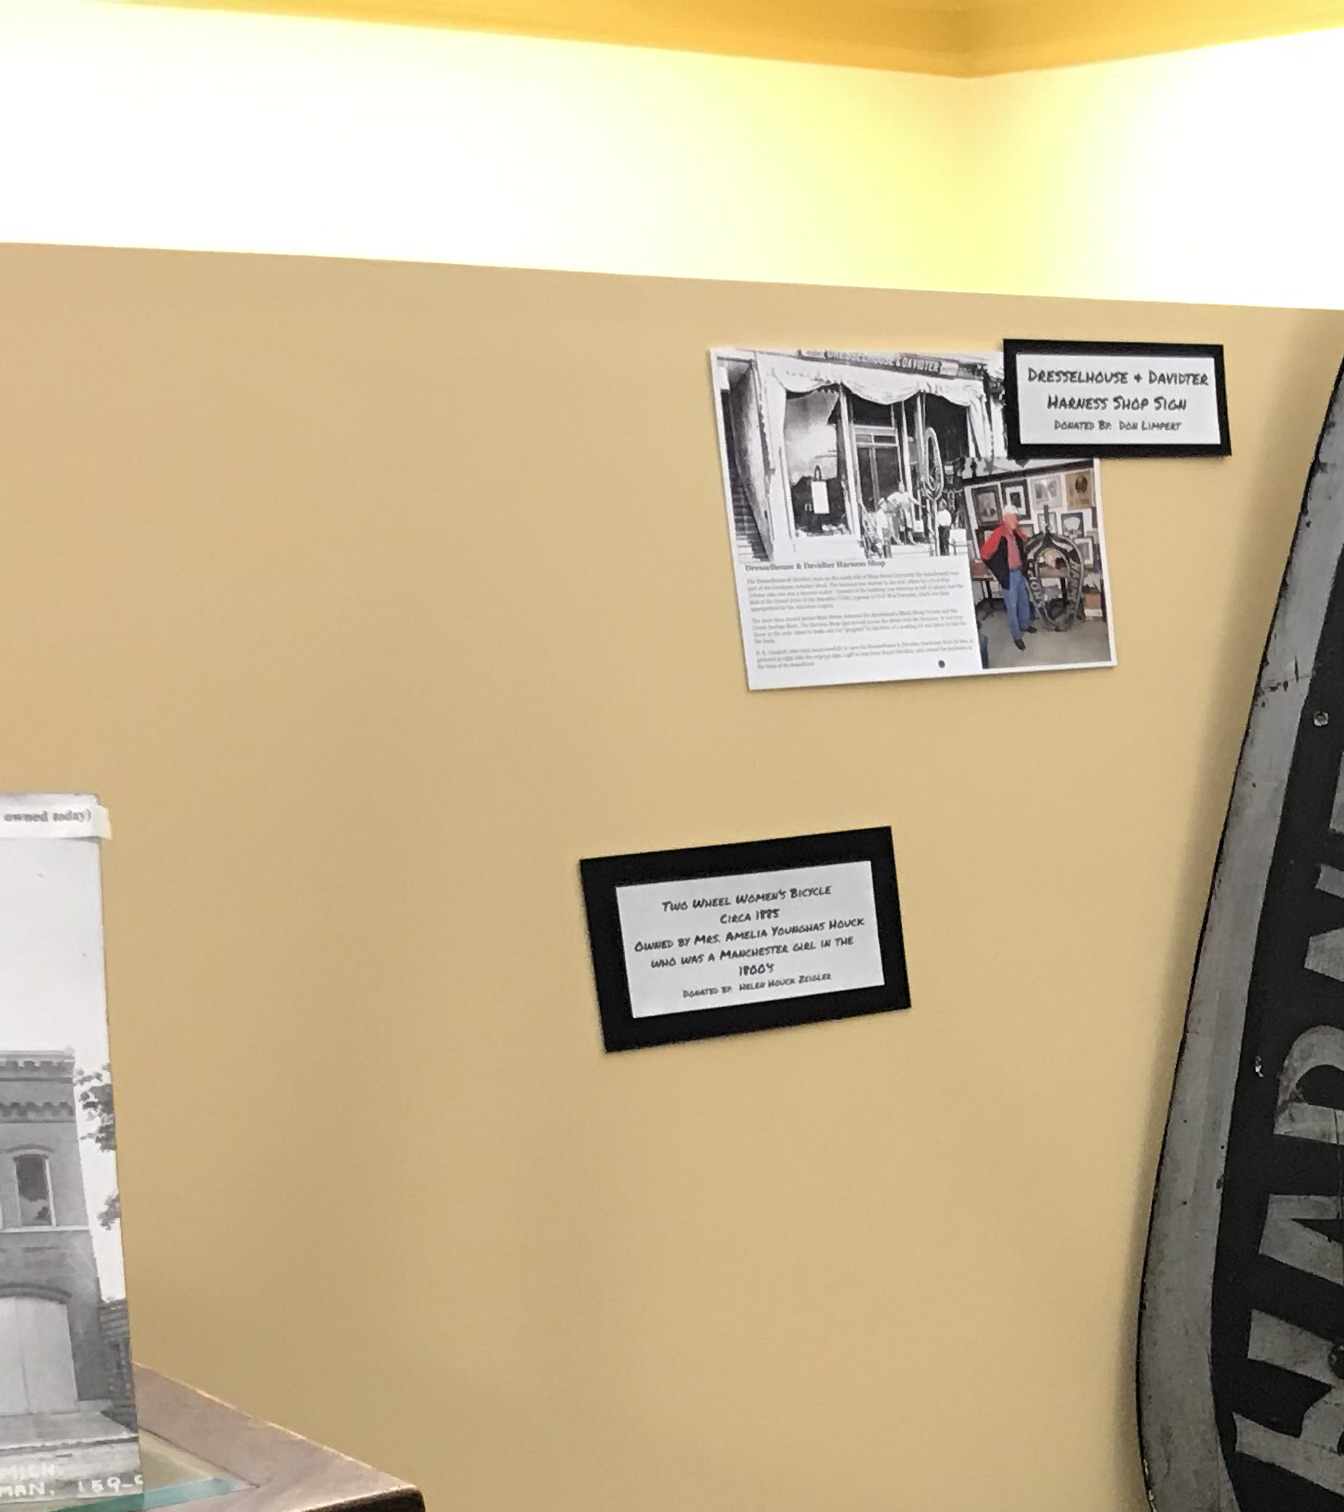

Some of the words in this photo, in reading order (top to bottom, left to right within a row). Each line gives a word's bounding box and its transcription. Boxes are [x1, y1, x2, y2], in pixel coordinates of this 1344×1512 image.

[1028, 367, 1128, 384] DRESSELHOUSE
[1149, 370, 1209, 386] DAVIDTER
[1047, 394, 1108, 410] HARNESS
[1113, 395, 1149, 411] SHOP
[1154, 396, 1187, 411] SIGN
[1054, 420, 1094, 430] DONATED
[1119, 421, 1137, 431] DON
[1141, 421, 1182, 431] LIMPERT
[4, 810, 48, 822] owned
[53, 808, 92, 823] today)
[662, 900, 688, 912] TWO
[692, 897, 732, 909] WHEEL
[735, 889, 787, 904] WOMEN'S
[790, 885, 832, 899] BICYCLE
[720, 913, 751, 924] CIRCA
[755, 908, 780, 921] 1885
[634, 940, 674, 952] OWNED
[677, 937, 690, 948] BY
[694, 934, 721, 945] MRS.
[725, 927, 768, 942] AMELIA
[828, 917, 865, 929] HOUCK
[651, 957, 676, 969] WHO
[681, 954, 704, 965] WAS
[708, 953, 715, 962] A
[719, 944, 789, 960] MANCHESTER
[792, 940, 816, 952] GIRL
[820, 938, 832, 948] IN
[835, 936, 854, 947] THE
[683, 987, 719, 998] DONATED
[739, 981, 766, 992] HELEN
[768, 977, 796, 988] HOUCK
[798, 973, 832, 984] ZEIGLER
